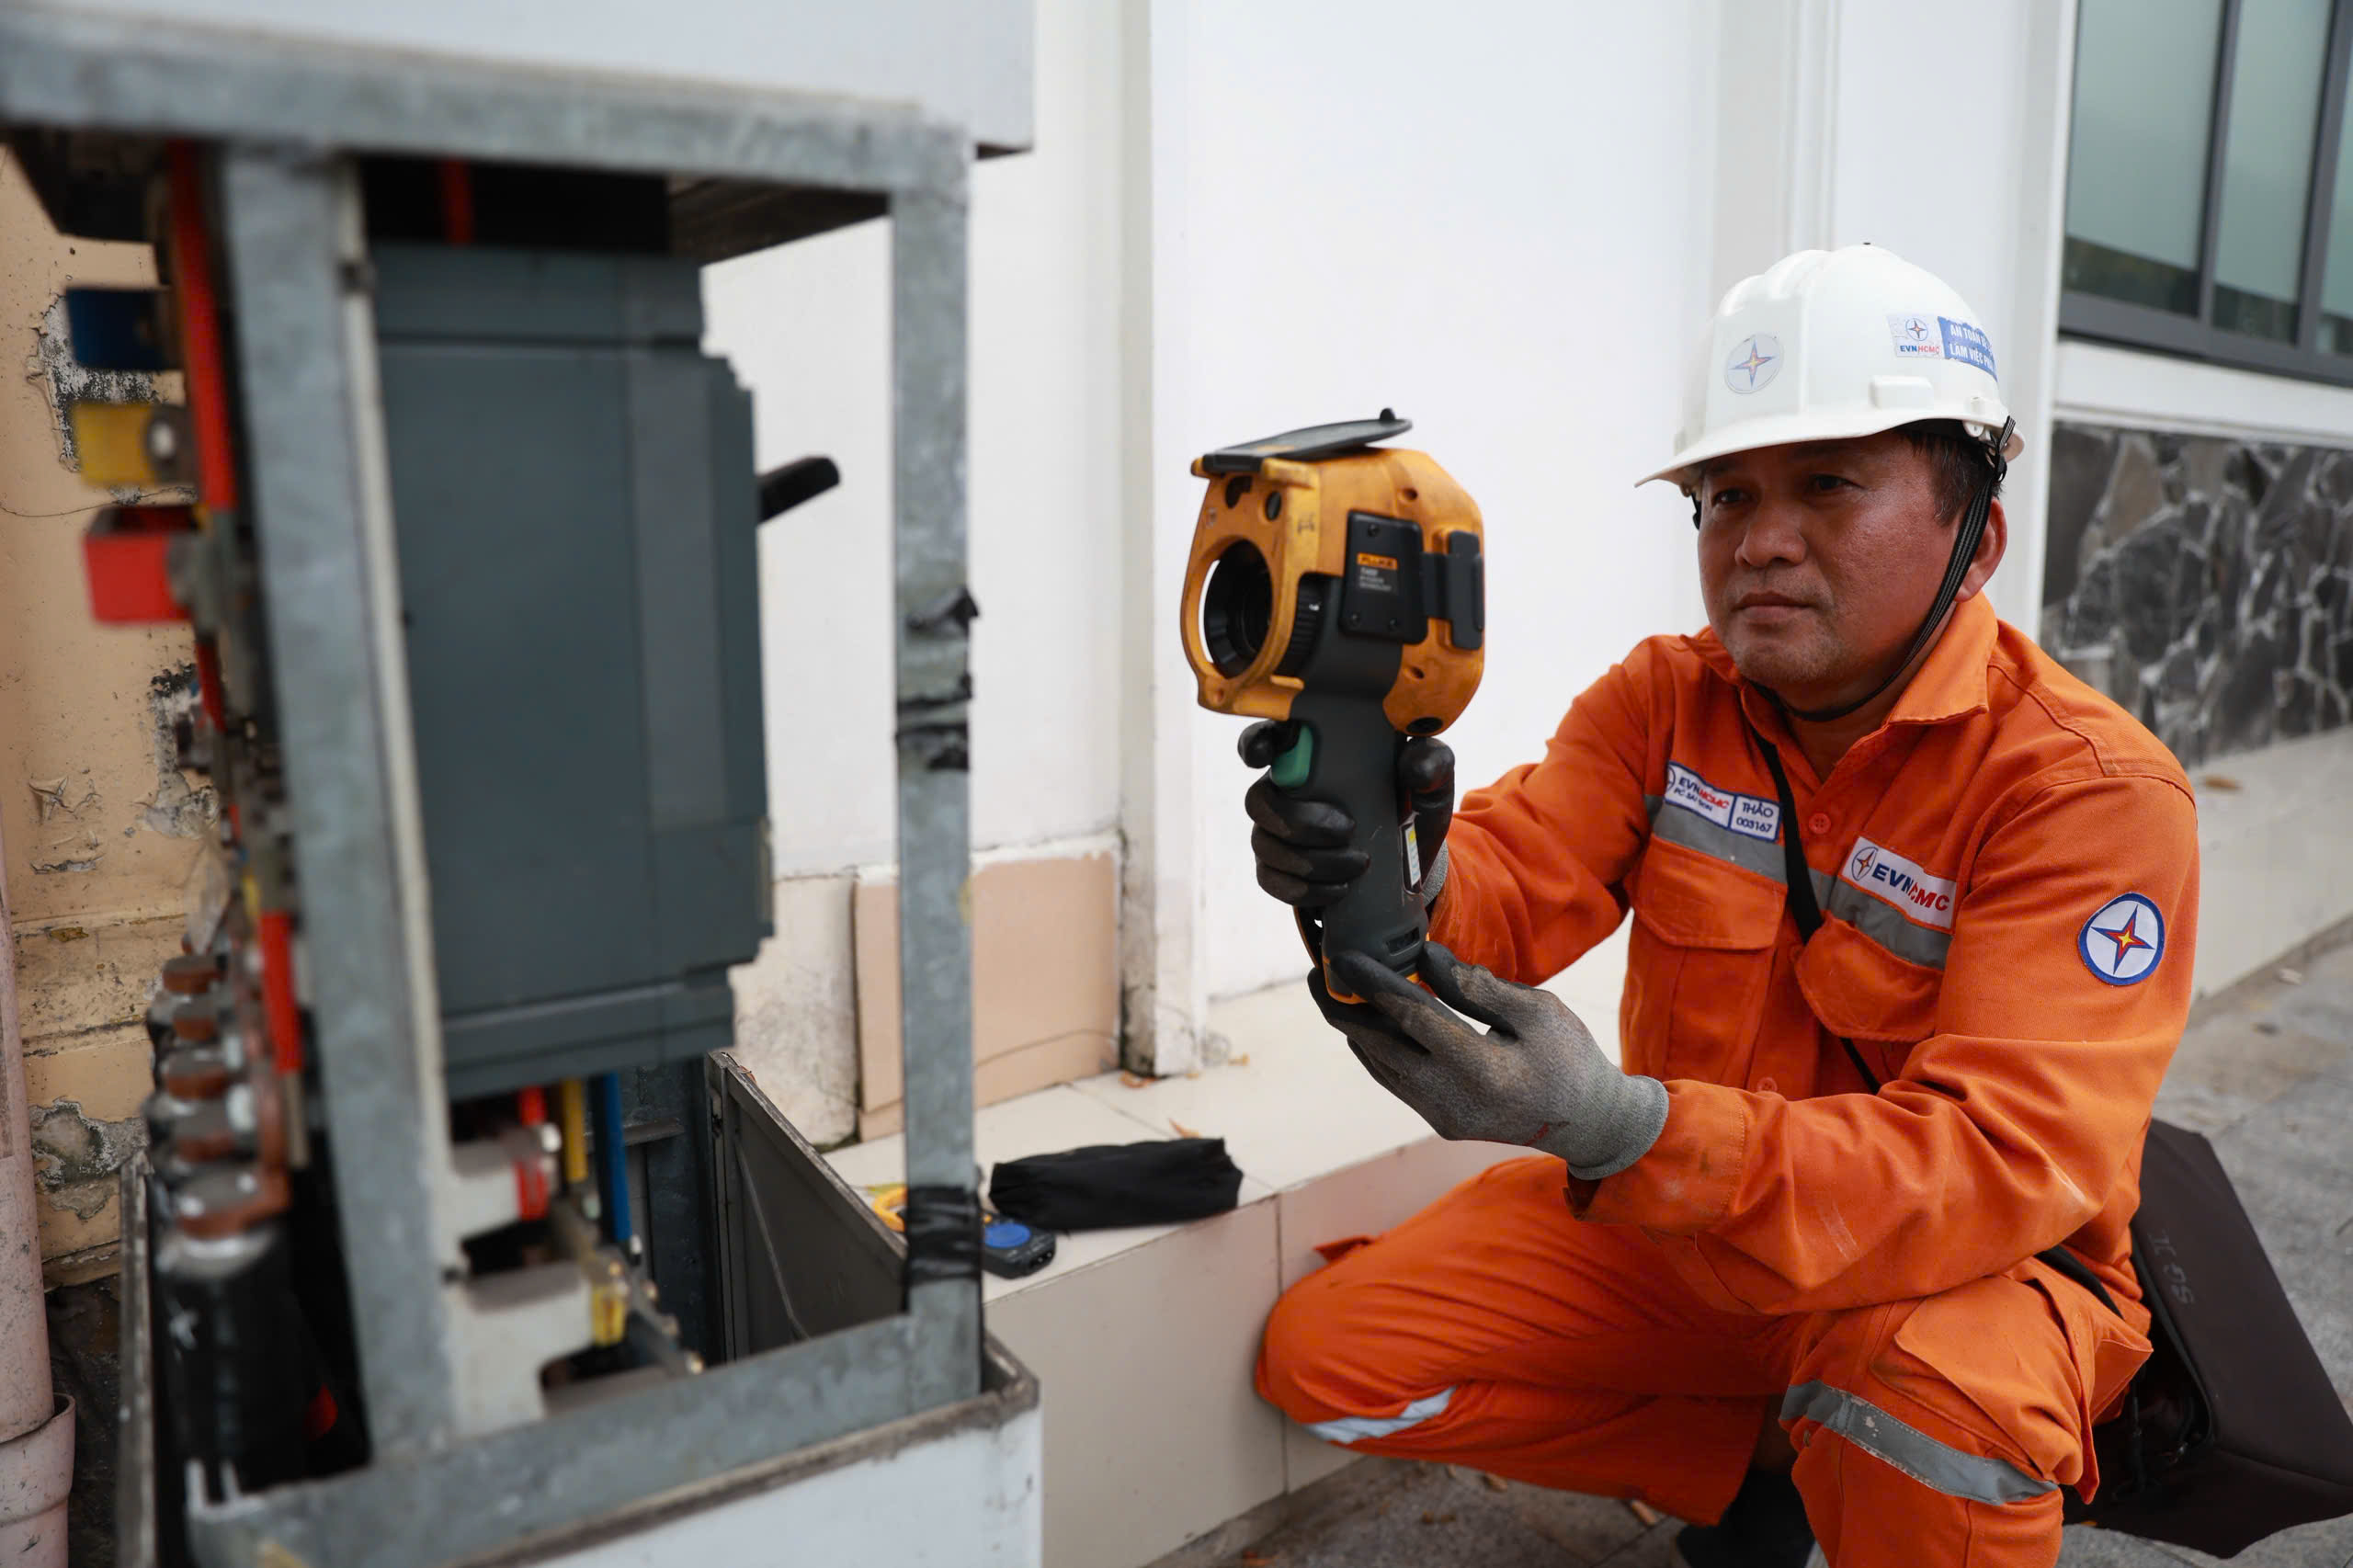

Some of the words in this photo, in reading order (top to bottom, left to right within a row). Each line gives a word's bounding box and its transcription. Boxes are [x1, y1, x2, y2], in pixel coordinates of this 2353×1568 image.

[1900, 345, 1940, 353] EVNHCMC
[1742, 801, 1774, 818] THẢO
[1735, 816, 1773, 833] 003167
